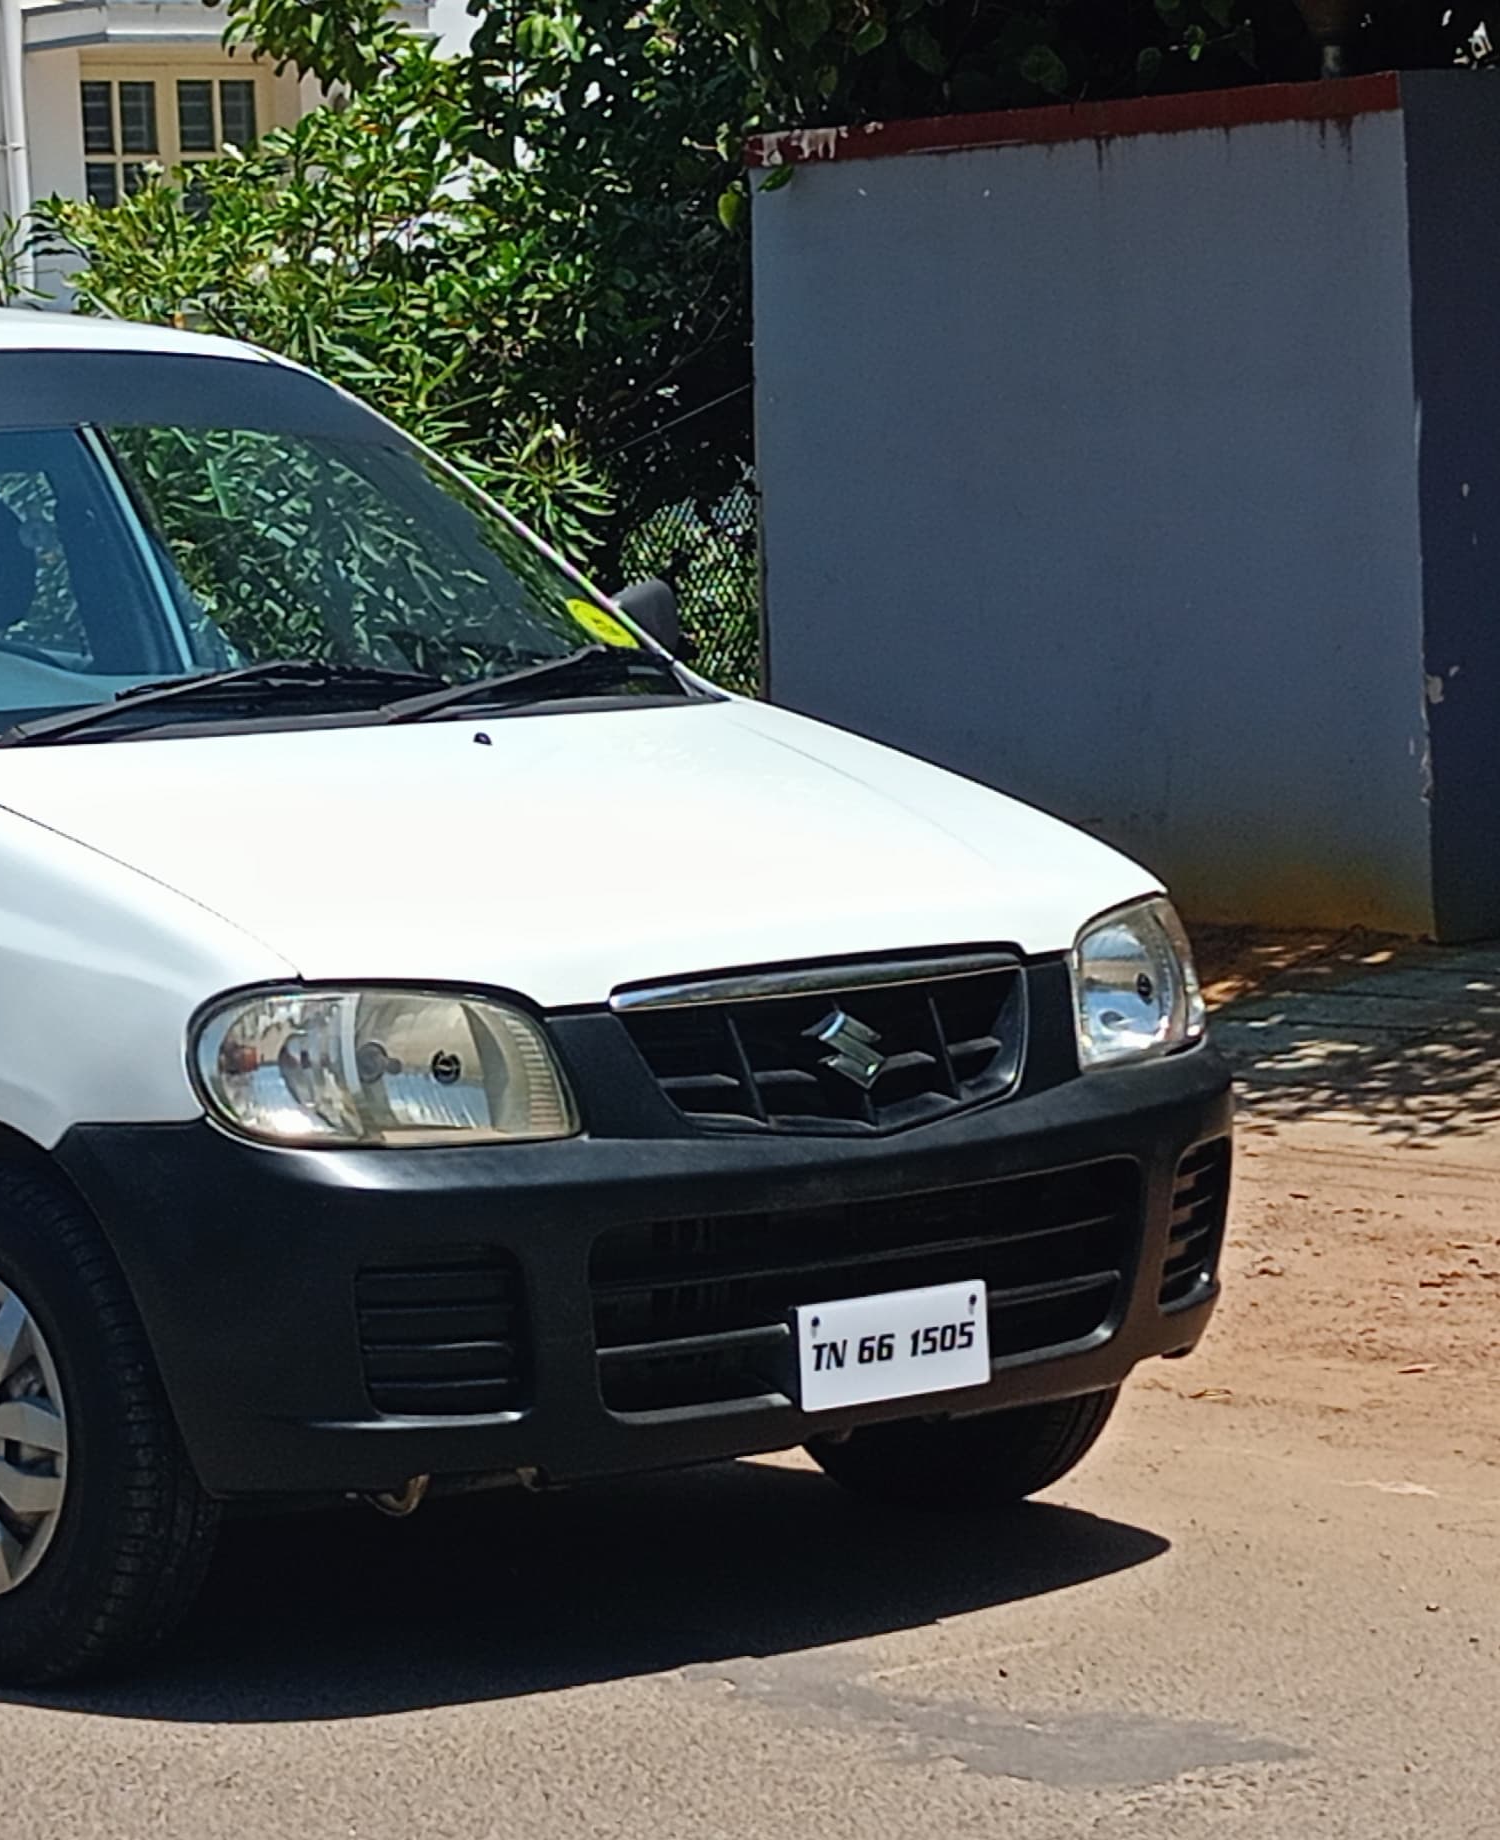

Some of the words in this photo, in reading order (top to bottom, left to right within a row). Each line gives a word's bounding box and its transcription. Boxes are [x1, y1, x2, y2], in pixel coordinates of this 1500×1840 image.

[812, 1339, 848, 1371] TN
[857, 1333, 895, 1364] 66
[910, 1321, 976, 1357] 1505
